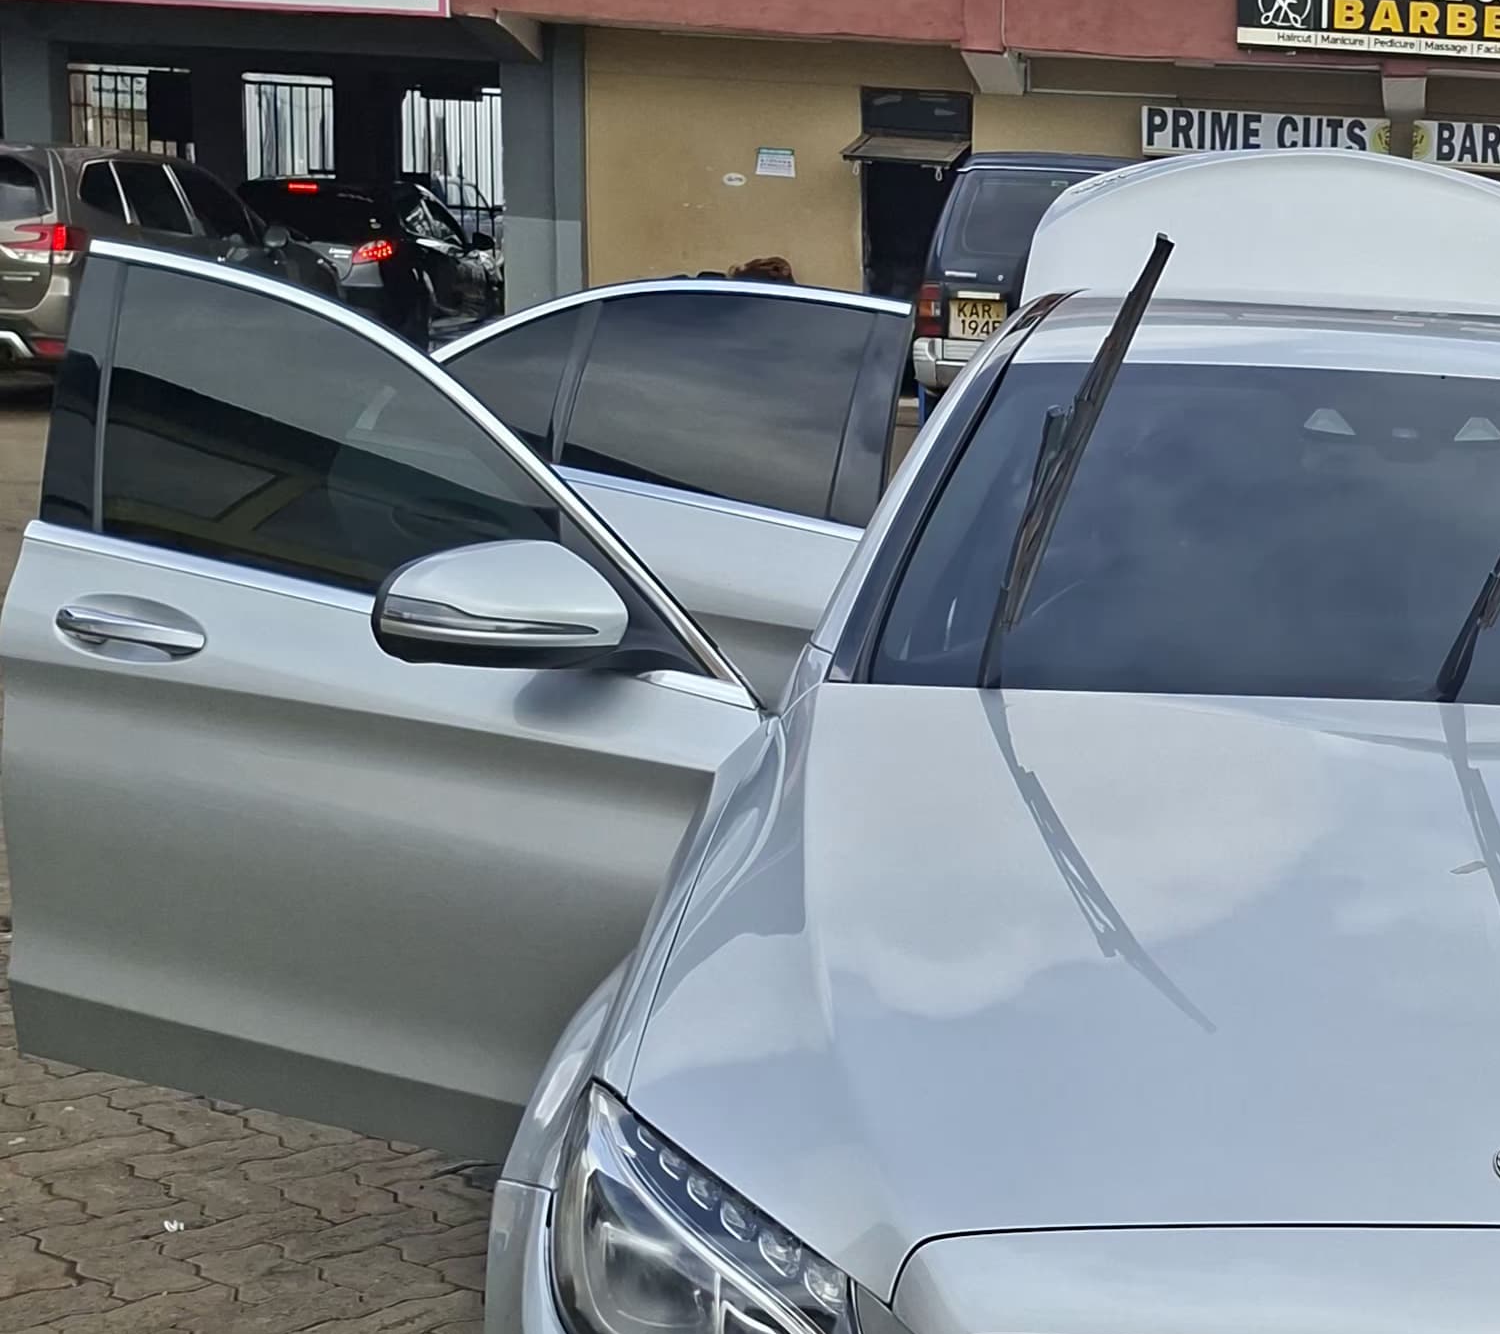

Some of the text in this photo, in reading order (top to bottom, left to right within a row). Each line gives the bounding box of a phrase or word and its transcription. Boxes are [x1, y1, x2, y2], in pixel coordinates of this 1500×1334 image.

[1277, 32, 1312, 43] Haircut
[1321, 34, 1365, 46] Manicure
[1373, 38, 1415, 49] Pedicure
[1425, 42, 1467, 54] Massage
[1145, 107, 1367, 152] PRIME CUTS
[957, 302, 992, 319] KAR
